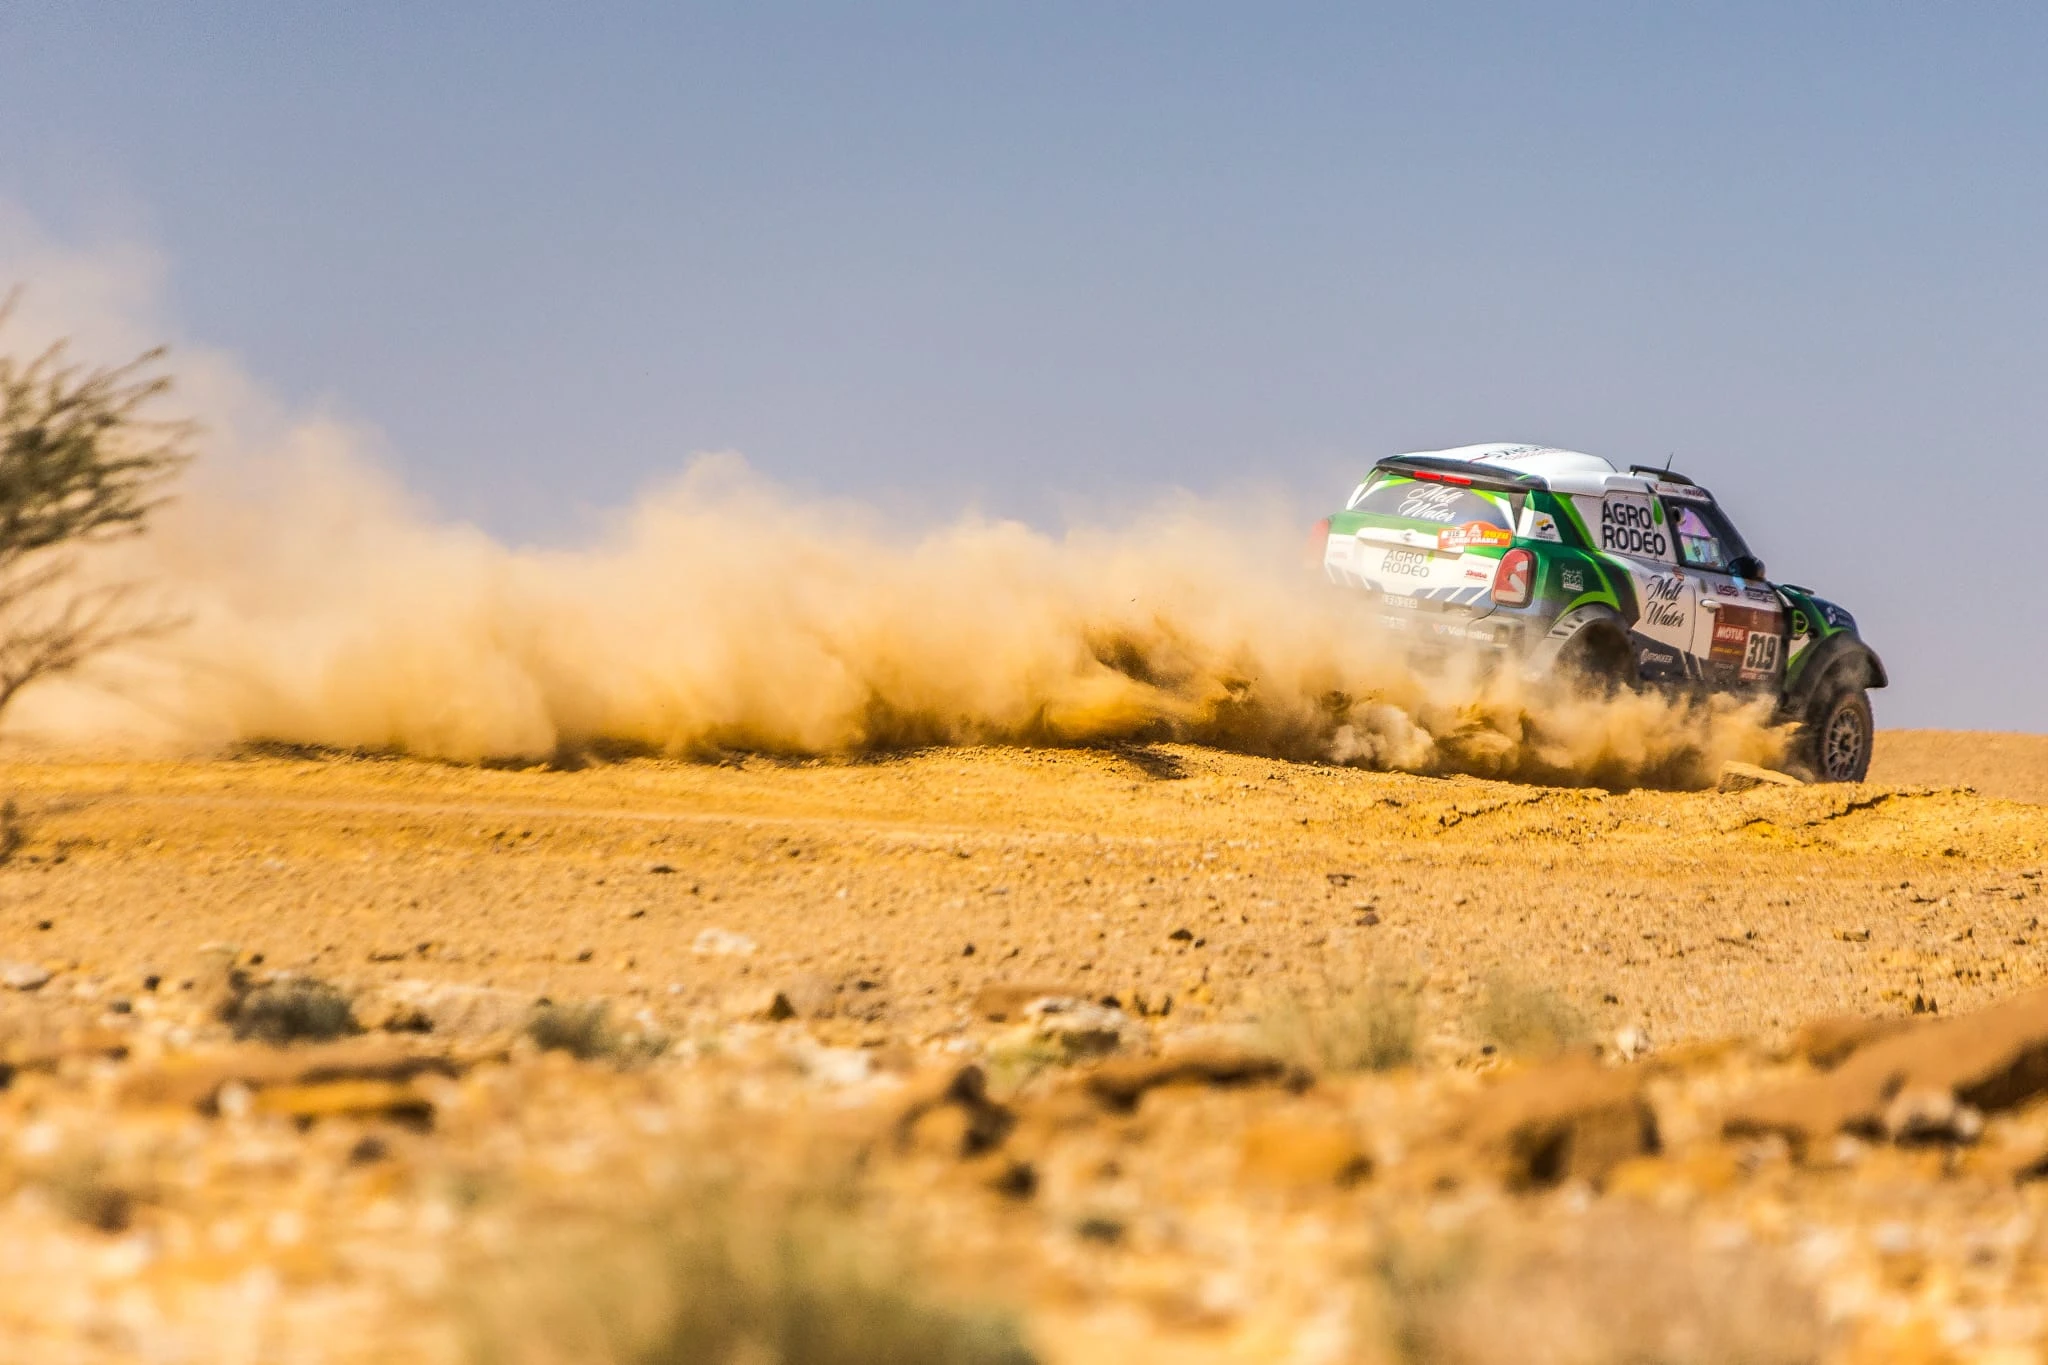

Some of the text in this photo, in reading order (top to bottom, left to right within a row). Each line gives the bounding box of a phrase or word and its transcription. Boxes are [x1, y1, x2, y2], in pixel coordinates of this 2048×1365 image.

[1602, 500, 1652, 529] AGRO
[1602, 524, 1666, 556] RODEO
[1381, 562, 1430, 579] RODEO
[1384, 550, 1425, 565] AGRO
[1646, 575, 1684, 601] Melt
[1645, 601, 1685, 628] Water
[1716, 626, 1745, 641] MOTUL
[1746, 633, 1778, 671] 319
